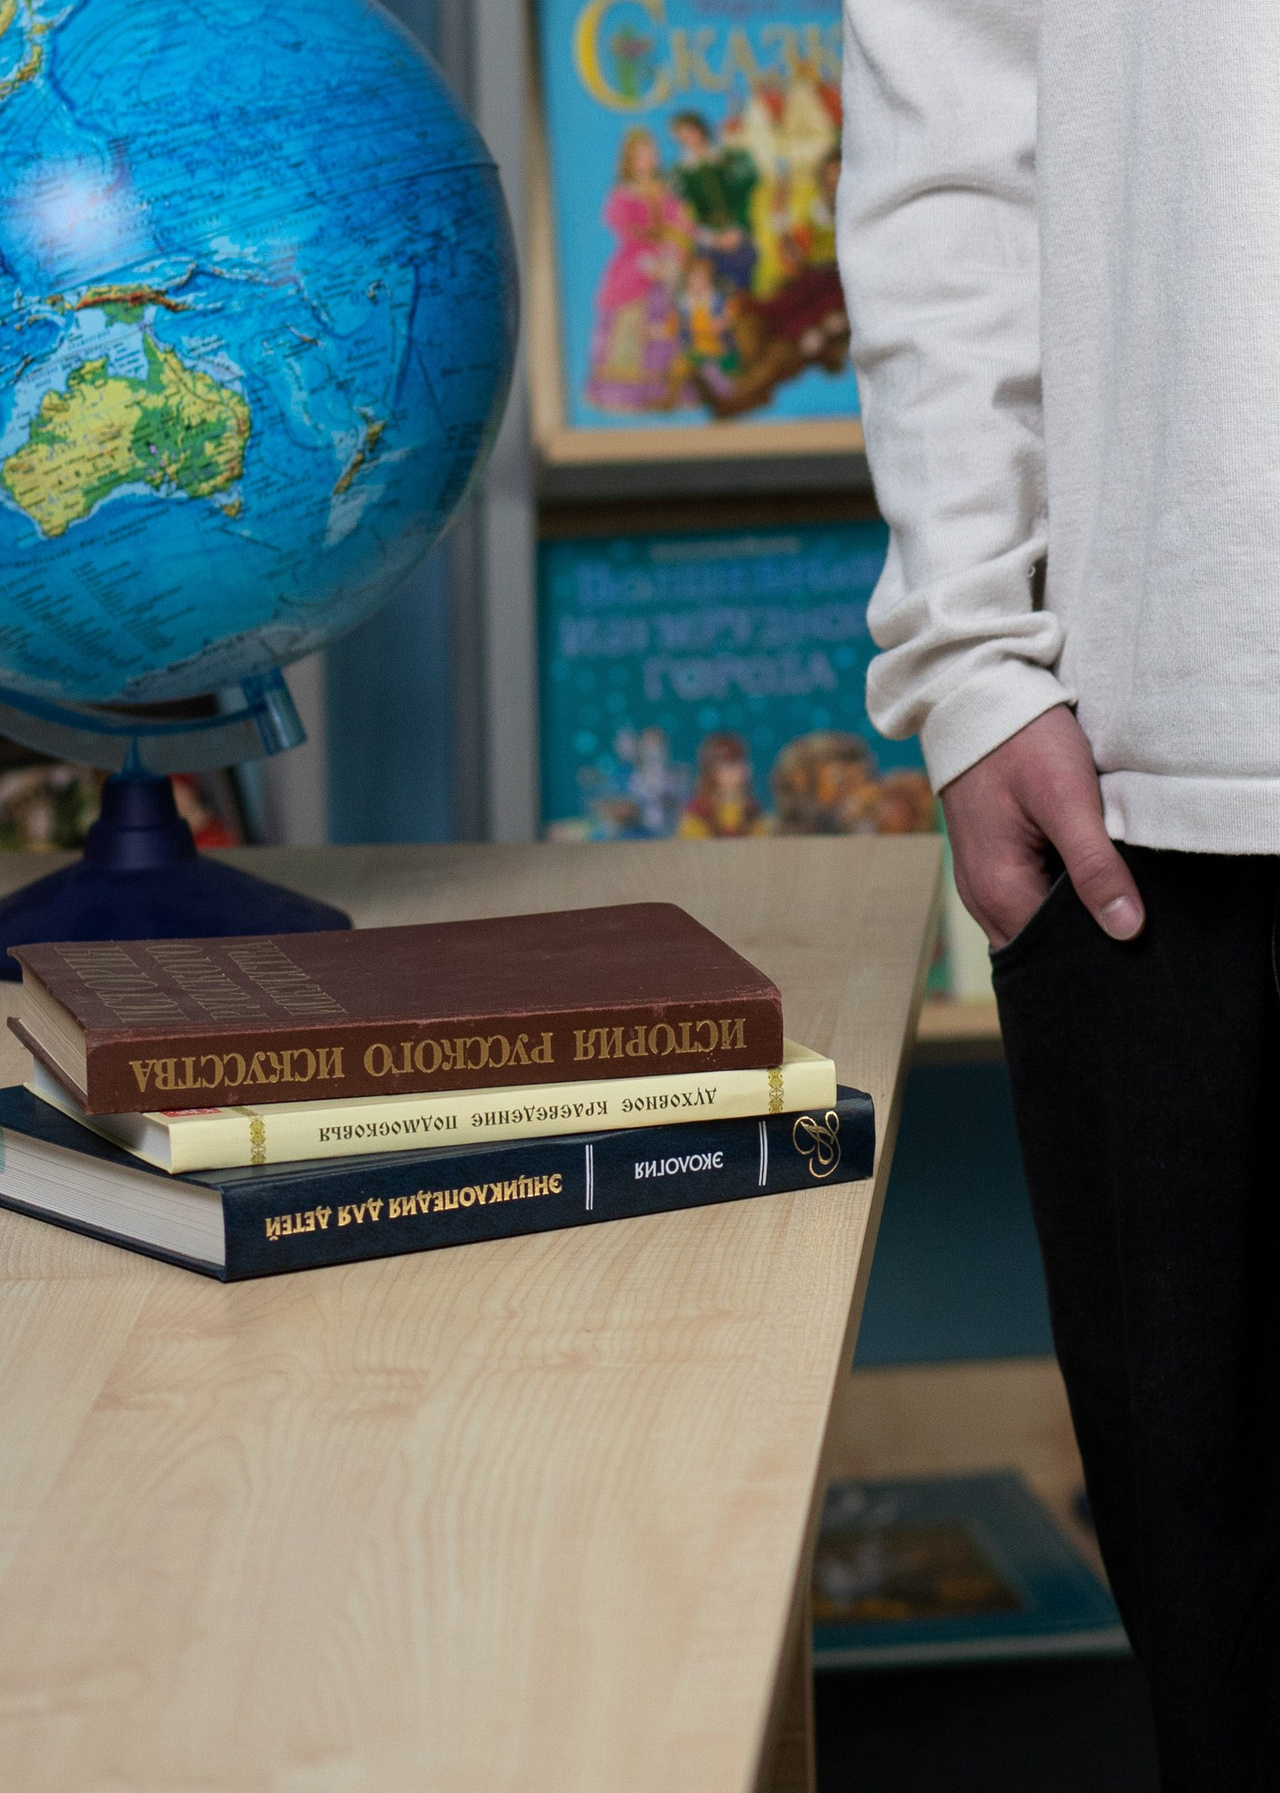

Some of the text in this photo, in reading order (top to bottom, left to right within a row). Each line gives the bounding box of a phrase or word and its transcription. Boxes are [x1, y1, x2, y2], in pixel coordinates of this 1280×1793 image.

[53, 945, 191, 1023] ИСТОРИЯ
[145, 944, 270, 1020] РУССКОГО
[129, 1018, 747, 1093] ИСТОРИЯ РУССКОГО ИСКУССТВА
[318, 1087, 717, 1142] ДУХОВНОЕ КРАЕВЕДЕНИЕ ПОДМОСКОВЬЯ
[634, 1150, 724, 1180] ЭКОЛОГИЯ
[265, 1173, 564, 1242] ЭНЦИКЛОПЕДИЯ ДЛЯ ДЕТЕЙ
